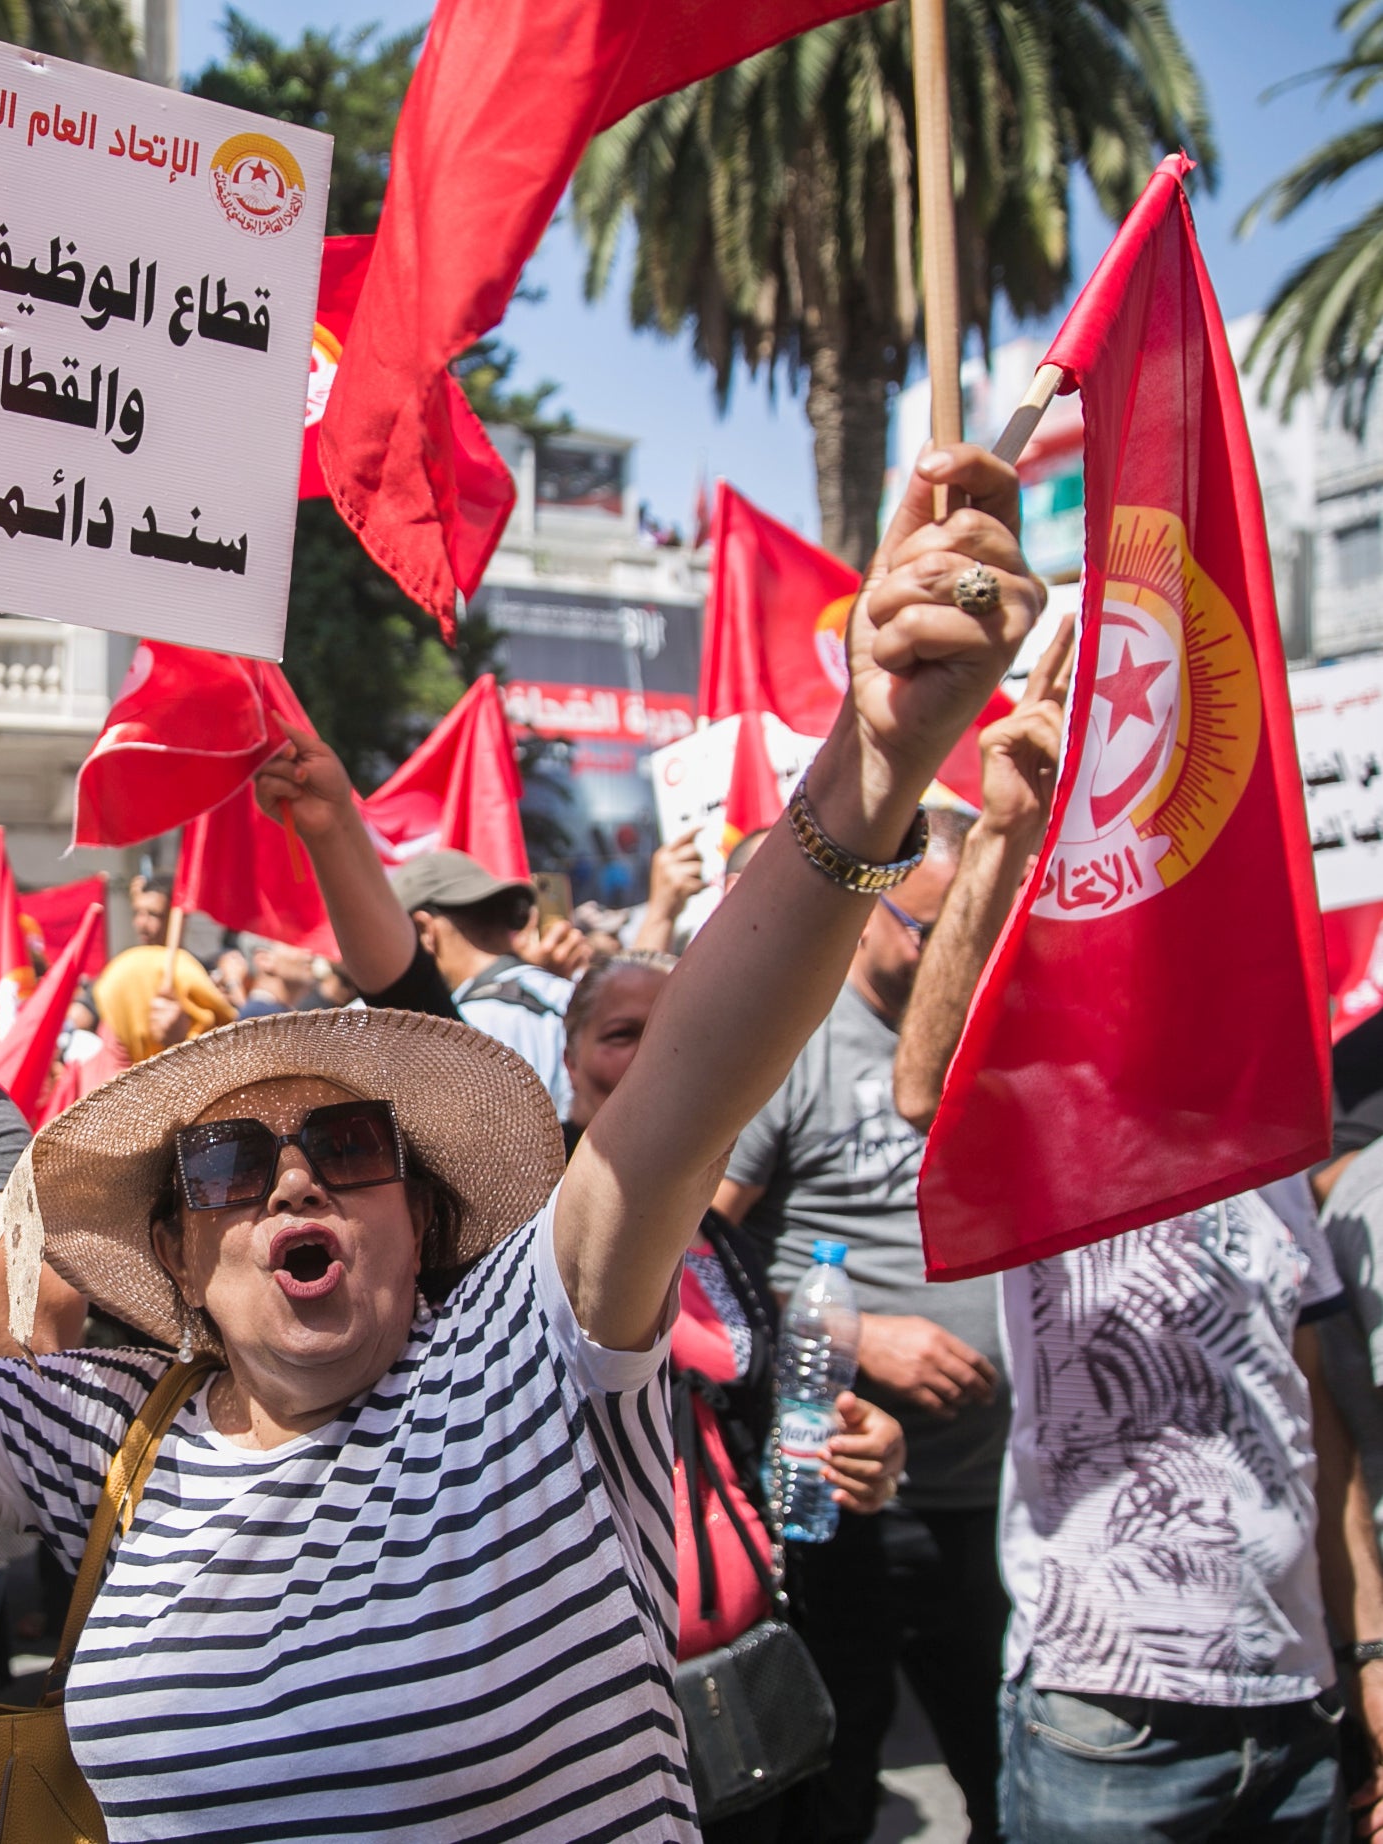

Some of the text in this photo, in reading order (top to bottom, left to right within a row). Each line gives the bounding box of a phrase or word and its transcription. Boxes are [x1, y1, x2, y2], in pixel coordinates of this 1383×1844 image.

[27, 104, 97, 150] العام
[108, 124, 199, 184] الإتحاد
[168, 272, 271, 353] قطاع
[129, 505, 247, 575] سند
